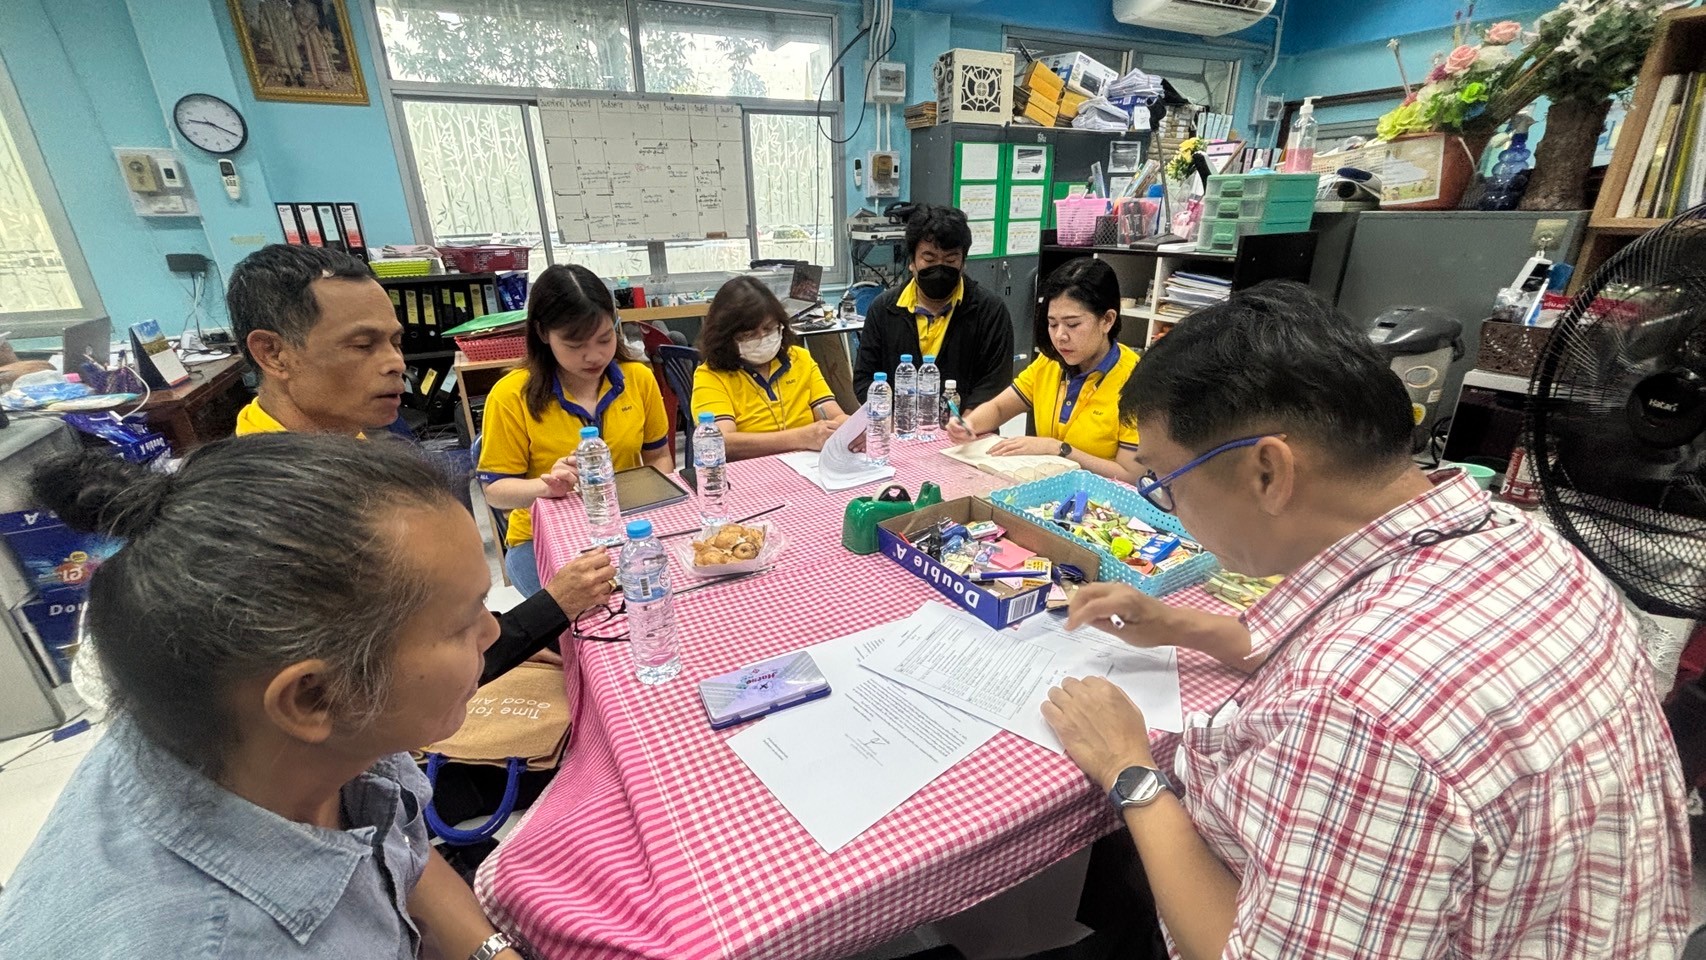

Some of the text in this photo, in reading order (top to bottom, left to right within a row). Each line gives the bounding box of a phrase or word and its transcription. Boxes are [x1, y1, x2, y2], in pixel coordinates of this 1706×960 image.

[896, 543, 980, 609] Double A
[468, 706, 540, 719] Time for
